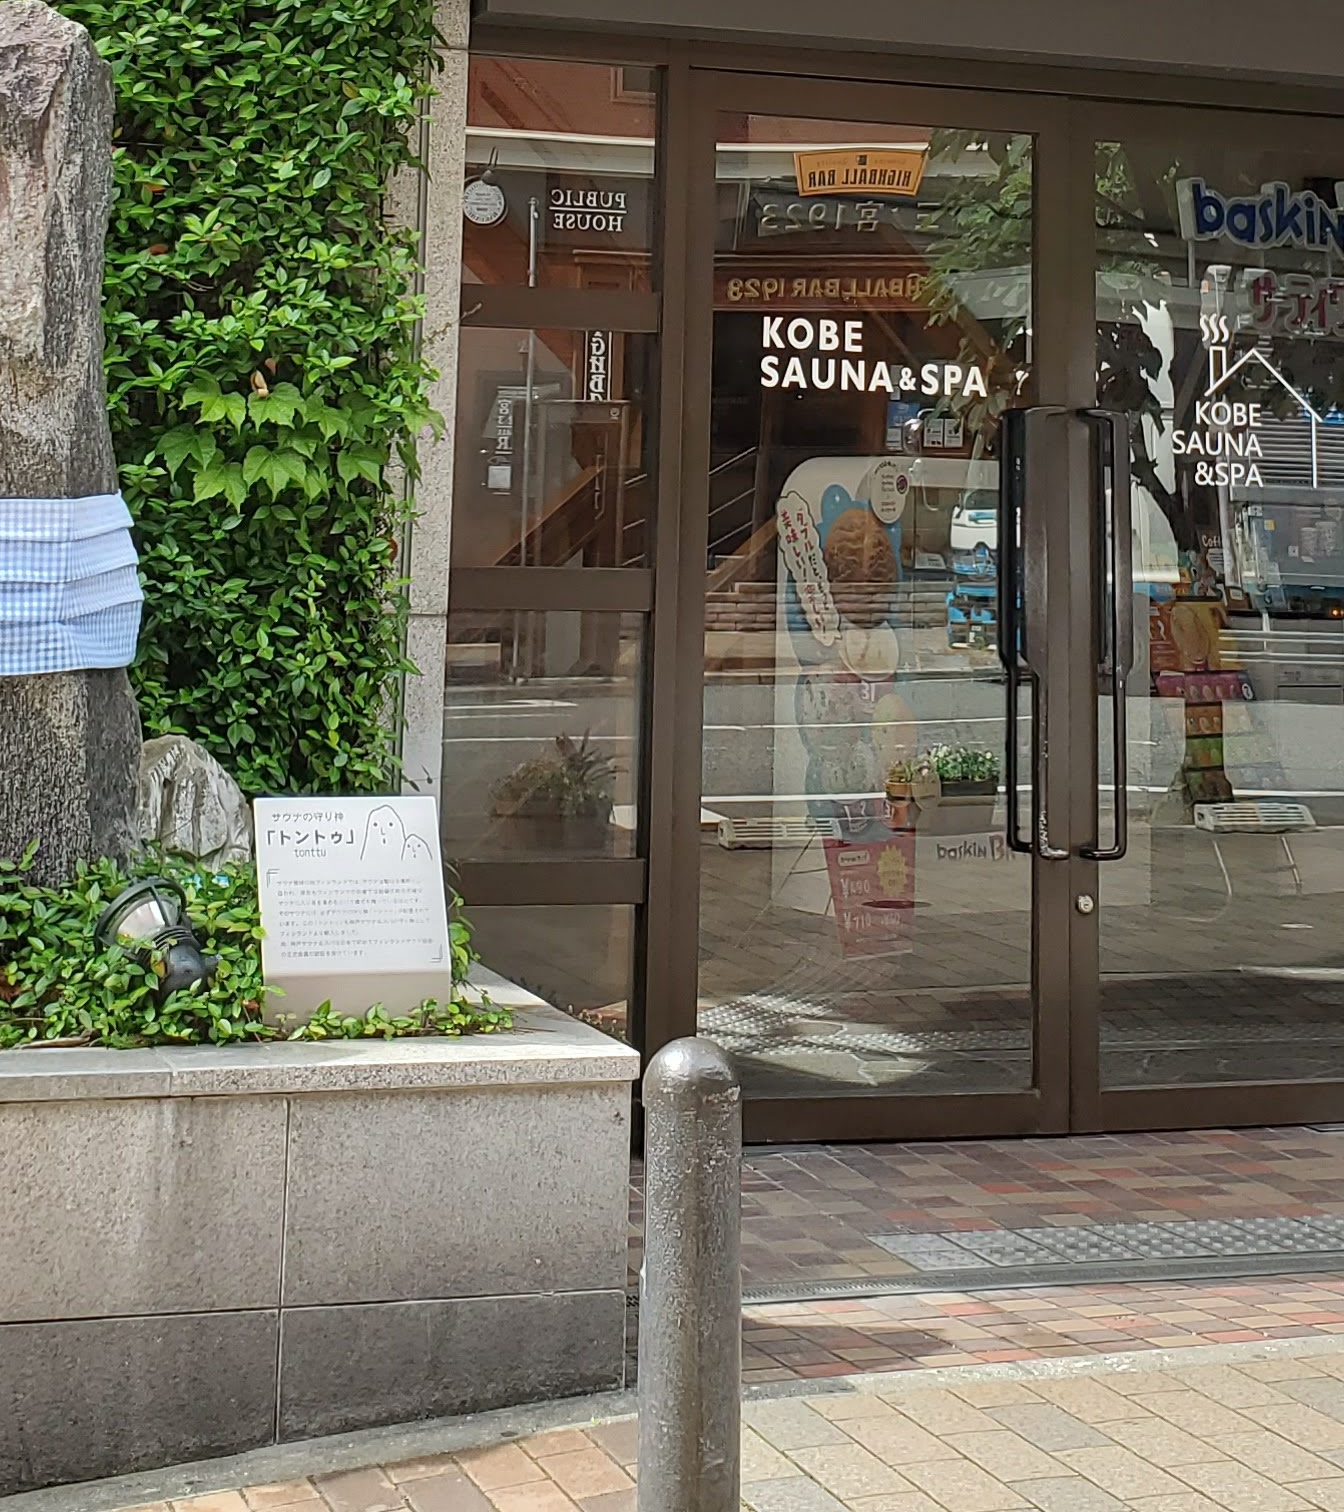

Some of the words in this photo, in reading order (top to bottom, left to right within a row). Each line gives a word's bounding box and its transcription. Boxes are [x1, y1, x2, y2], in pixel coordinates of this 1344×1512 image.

[761, 316, 863, 352] KOBE
[1194, 401, 1261, 426] KOBE
[1172, 430, 1263, 457] SAUNA
[1194, 461, 1263, 487] &SPA
[294, 847, 327, 858] tonttu
